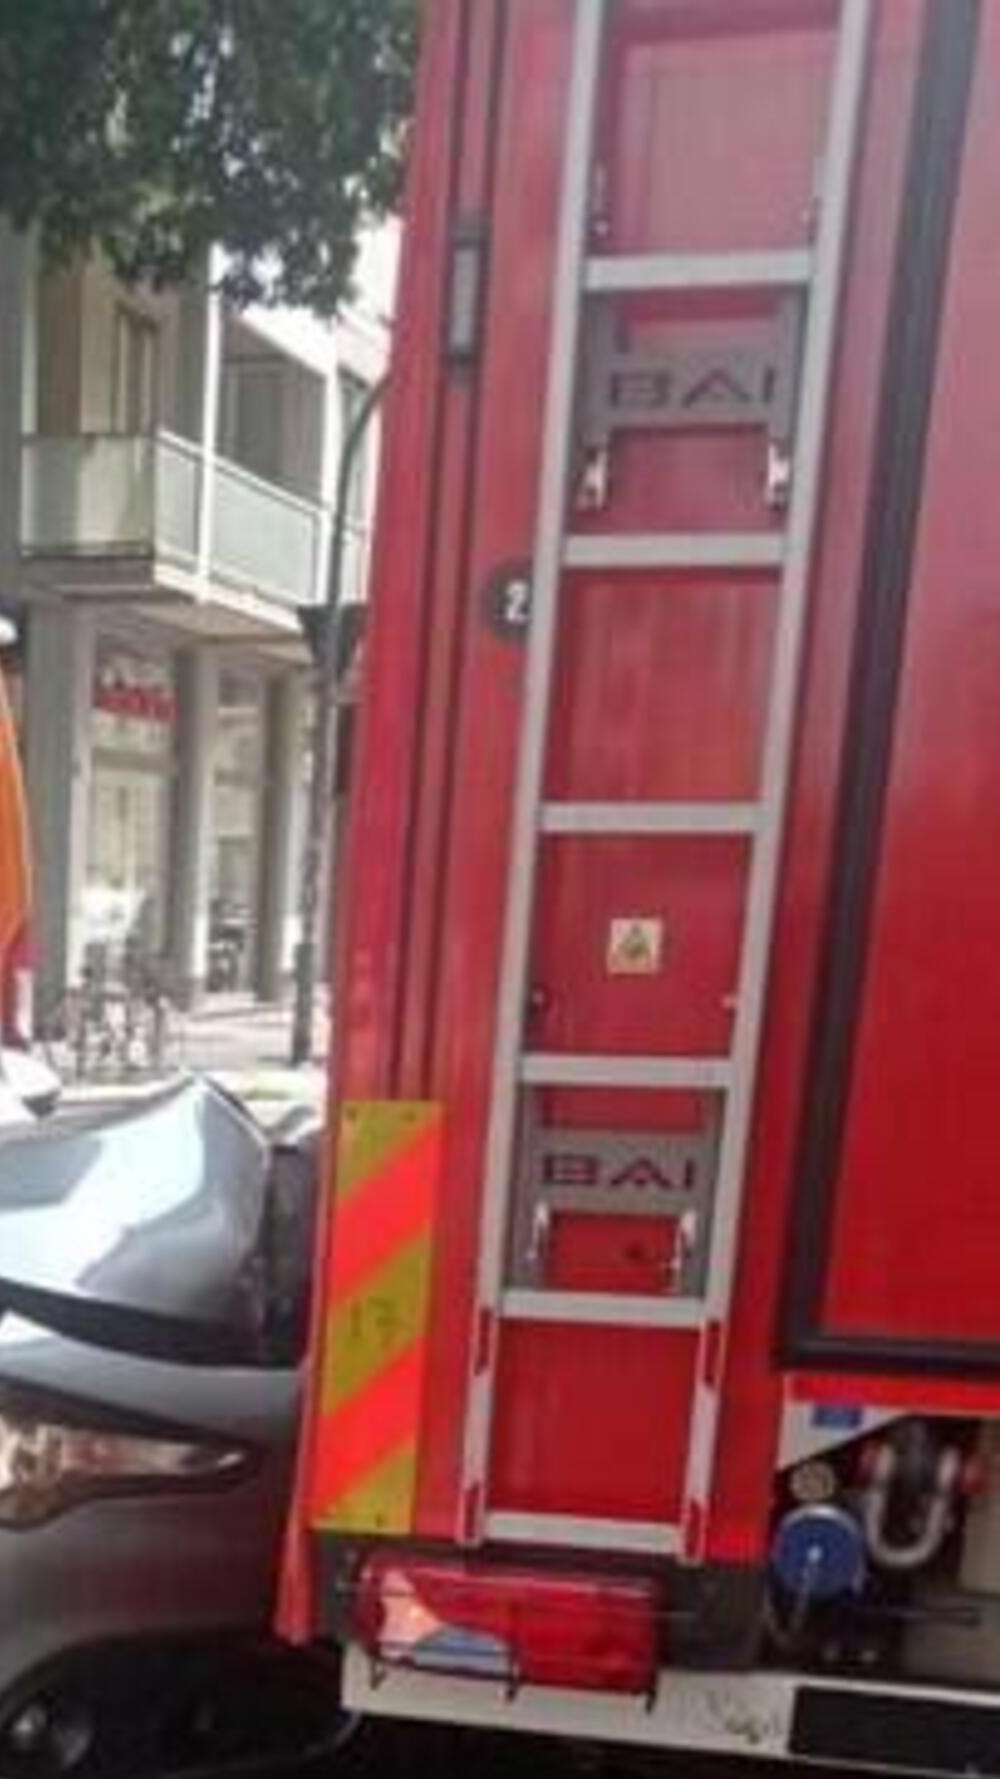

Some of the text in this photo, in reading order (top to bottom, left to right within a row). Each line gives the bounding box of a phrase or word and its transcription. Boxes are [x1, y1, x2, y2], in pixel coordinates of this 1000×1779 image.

[609, 365, 777, 412] BAI
[506, 580, 531, 624] 2
[540, 1152, 697, 1191] BAI
